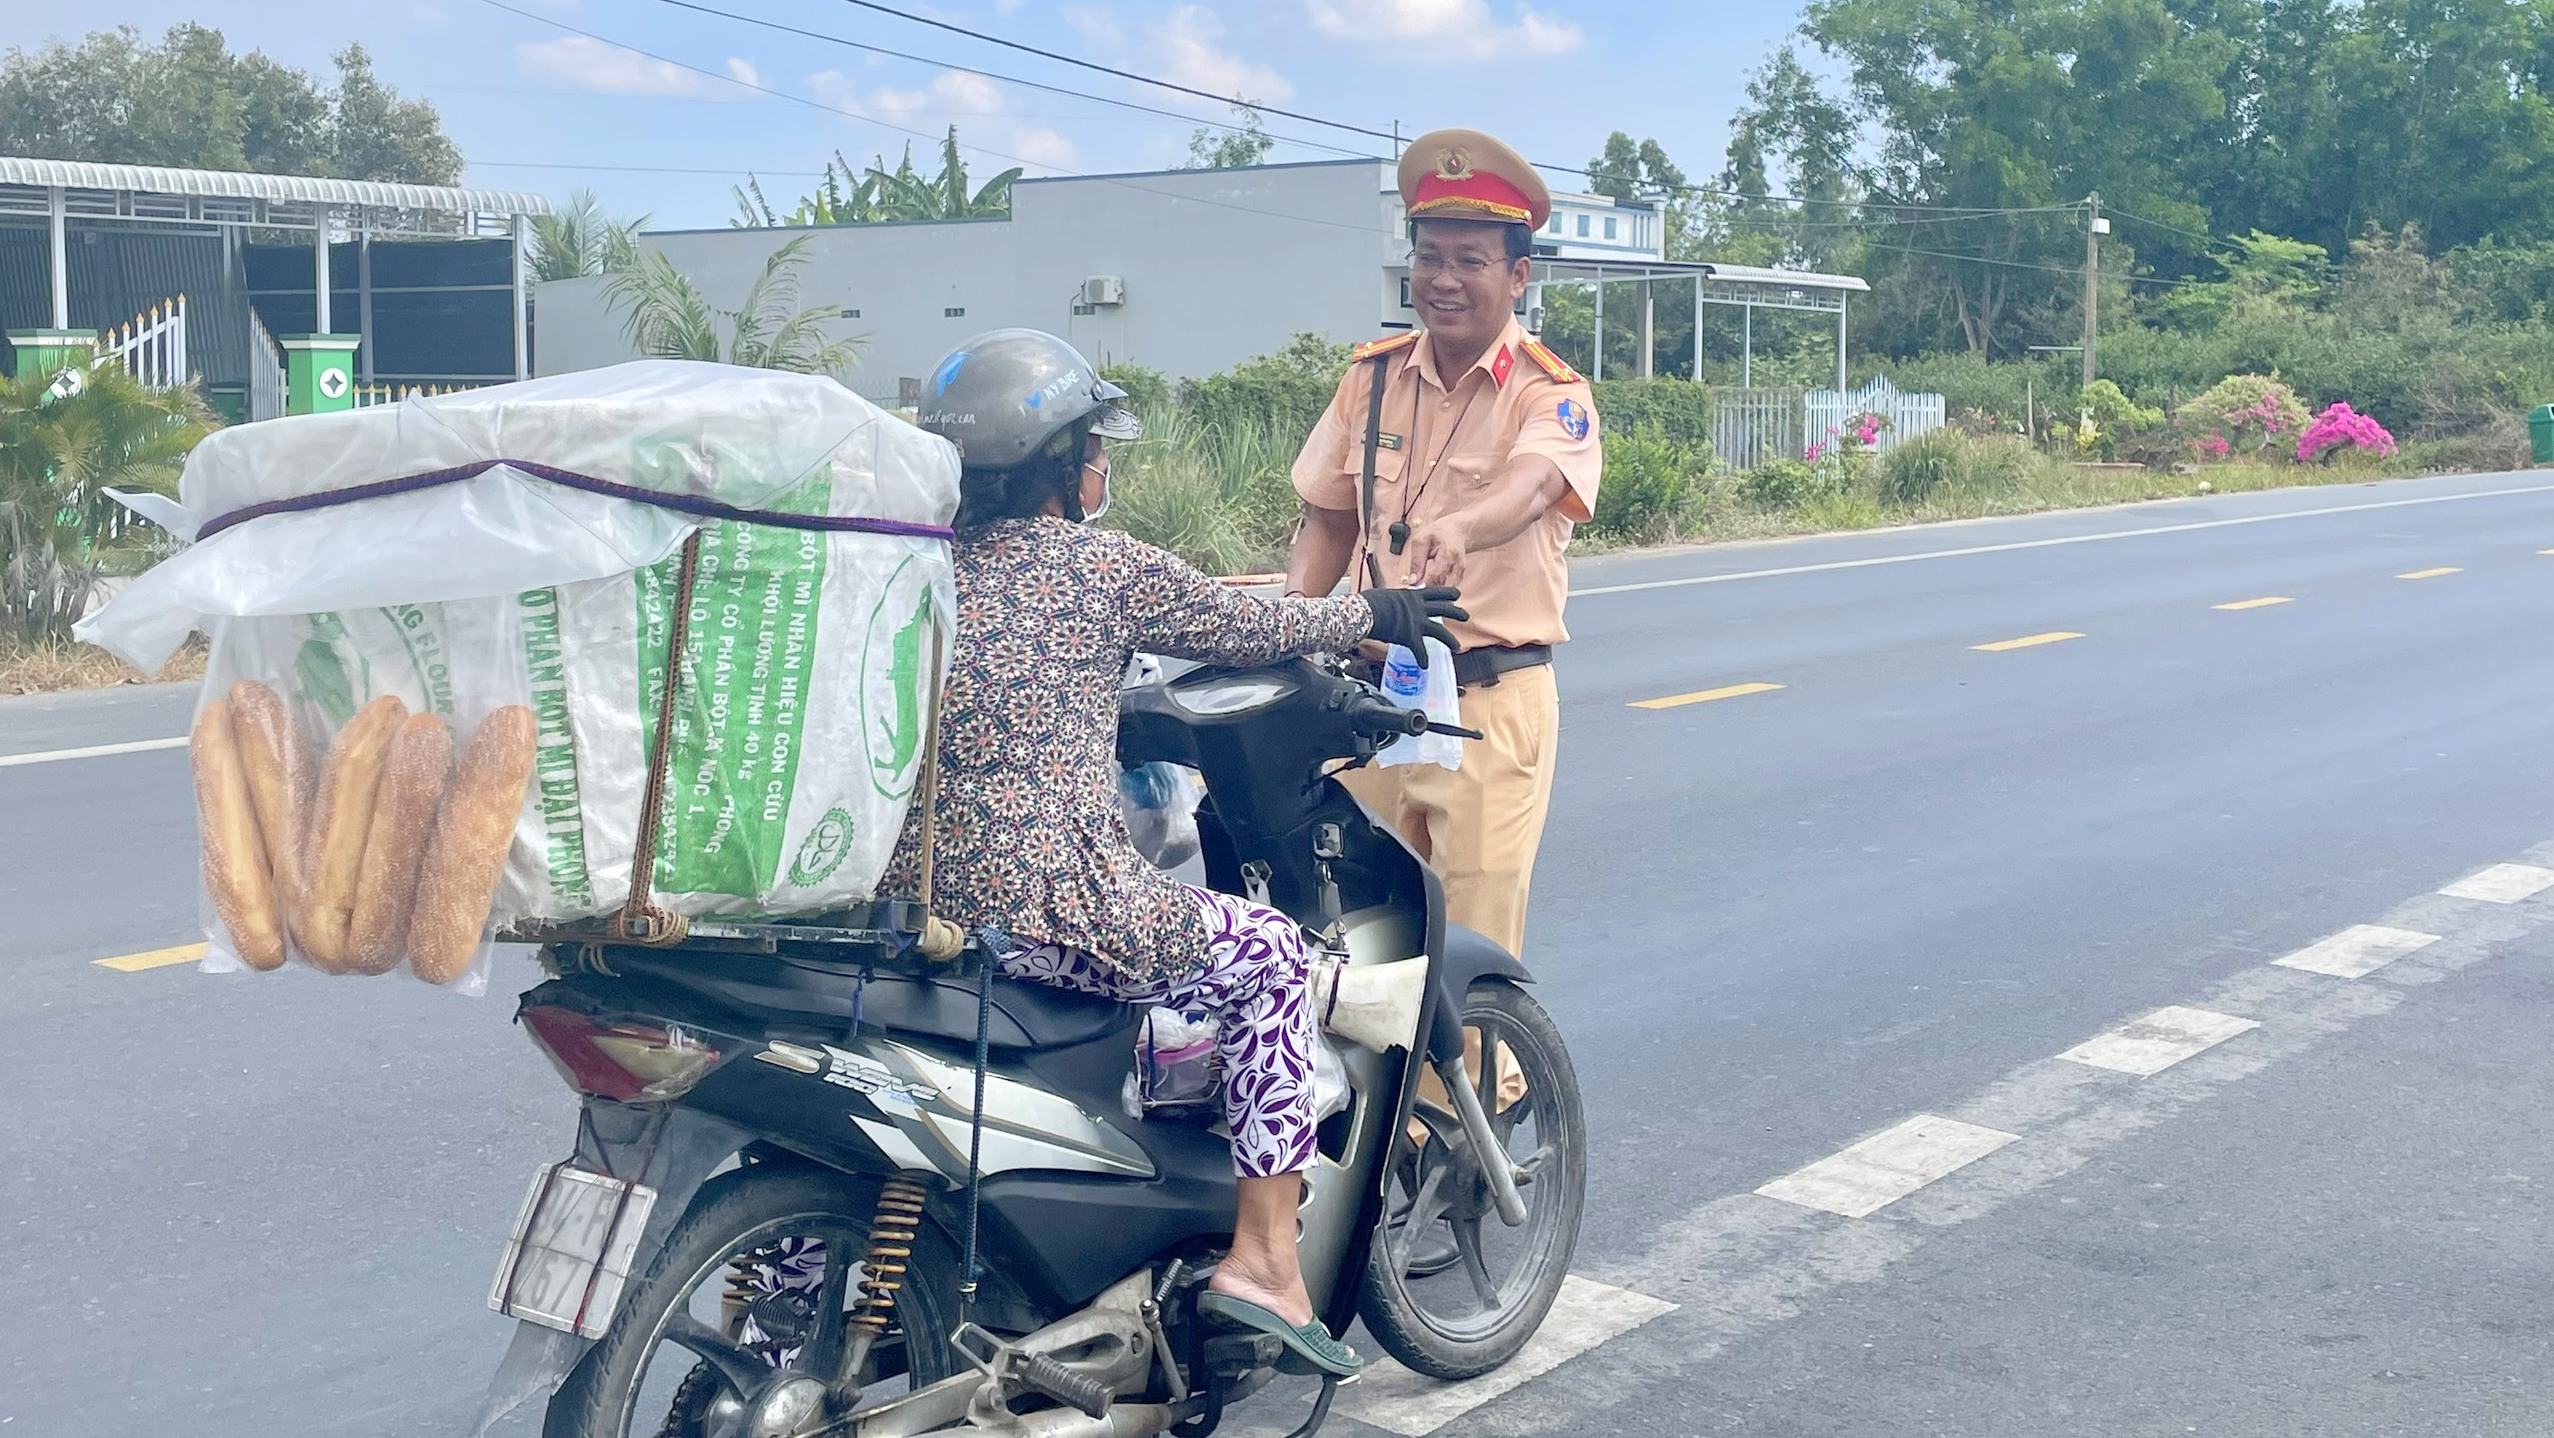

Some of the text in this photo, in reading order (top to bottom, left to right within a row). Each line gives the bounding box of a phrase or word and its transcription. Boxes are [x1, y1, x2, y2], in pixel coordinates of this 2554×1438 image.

[734, 520, 757, 572] CÔNG
[797, 532, 822, 573] BỘT
[727, 575, 747, 599] TY
[793, 581, 813, 606] MÌ
[691, 596, 711, 623] LÔ
[721, 603, 745, 631] CỔ
[783, 612, 807, 670] NHÃN
[747, 682, 768, 726] TỊNH
[775, 676, 799, 726] HIỆU
[744, 731, 760, 754] 40
[771, 732, 791, 774] CON
[737, 759, 757, 781] kg
[753, 1039, 827, 1075] S
